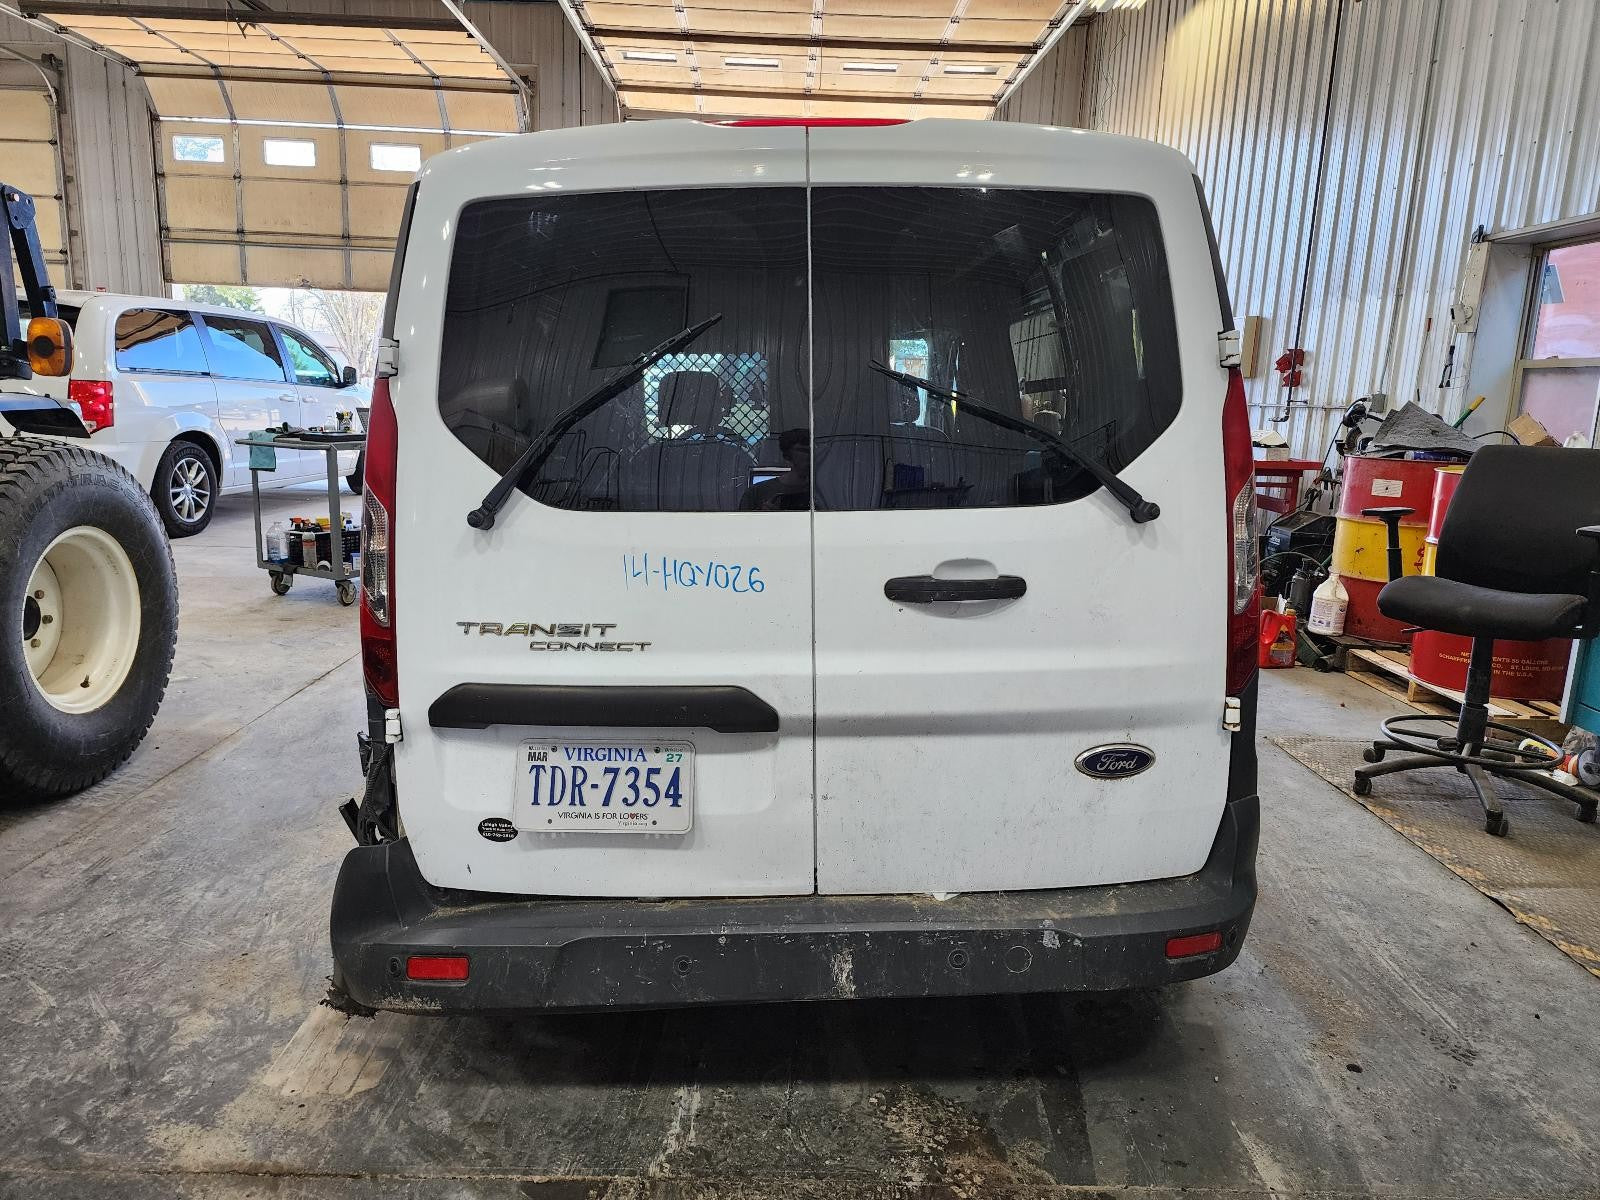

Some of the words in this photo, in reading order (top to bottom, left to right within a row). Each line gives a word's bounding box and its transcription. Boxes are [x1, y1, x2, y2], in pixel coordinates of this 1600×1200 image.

[456, 621, 618, 637] TRANSIT
[529, 641, 652, 652] CONNECT
[527, 751, 548, 762] MAR
[564, 746, 648, 762] VIRGINIA
[665, 753, 683, 763] 27
[1096, 752, 1138, 771] Ford
[528, 764, 683, 808] TDR-7354
[557, 811, 593, 820] VIRGINIA
[594, 812, 601, 820] IS
[602, 812, 618, 820] FOR
